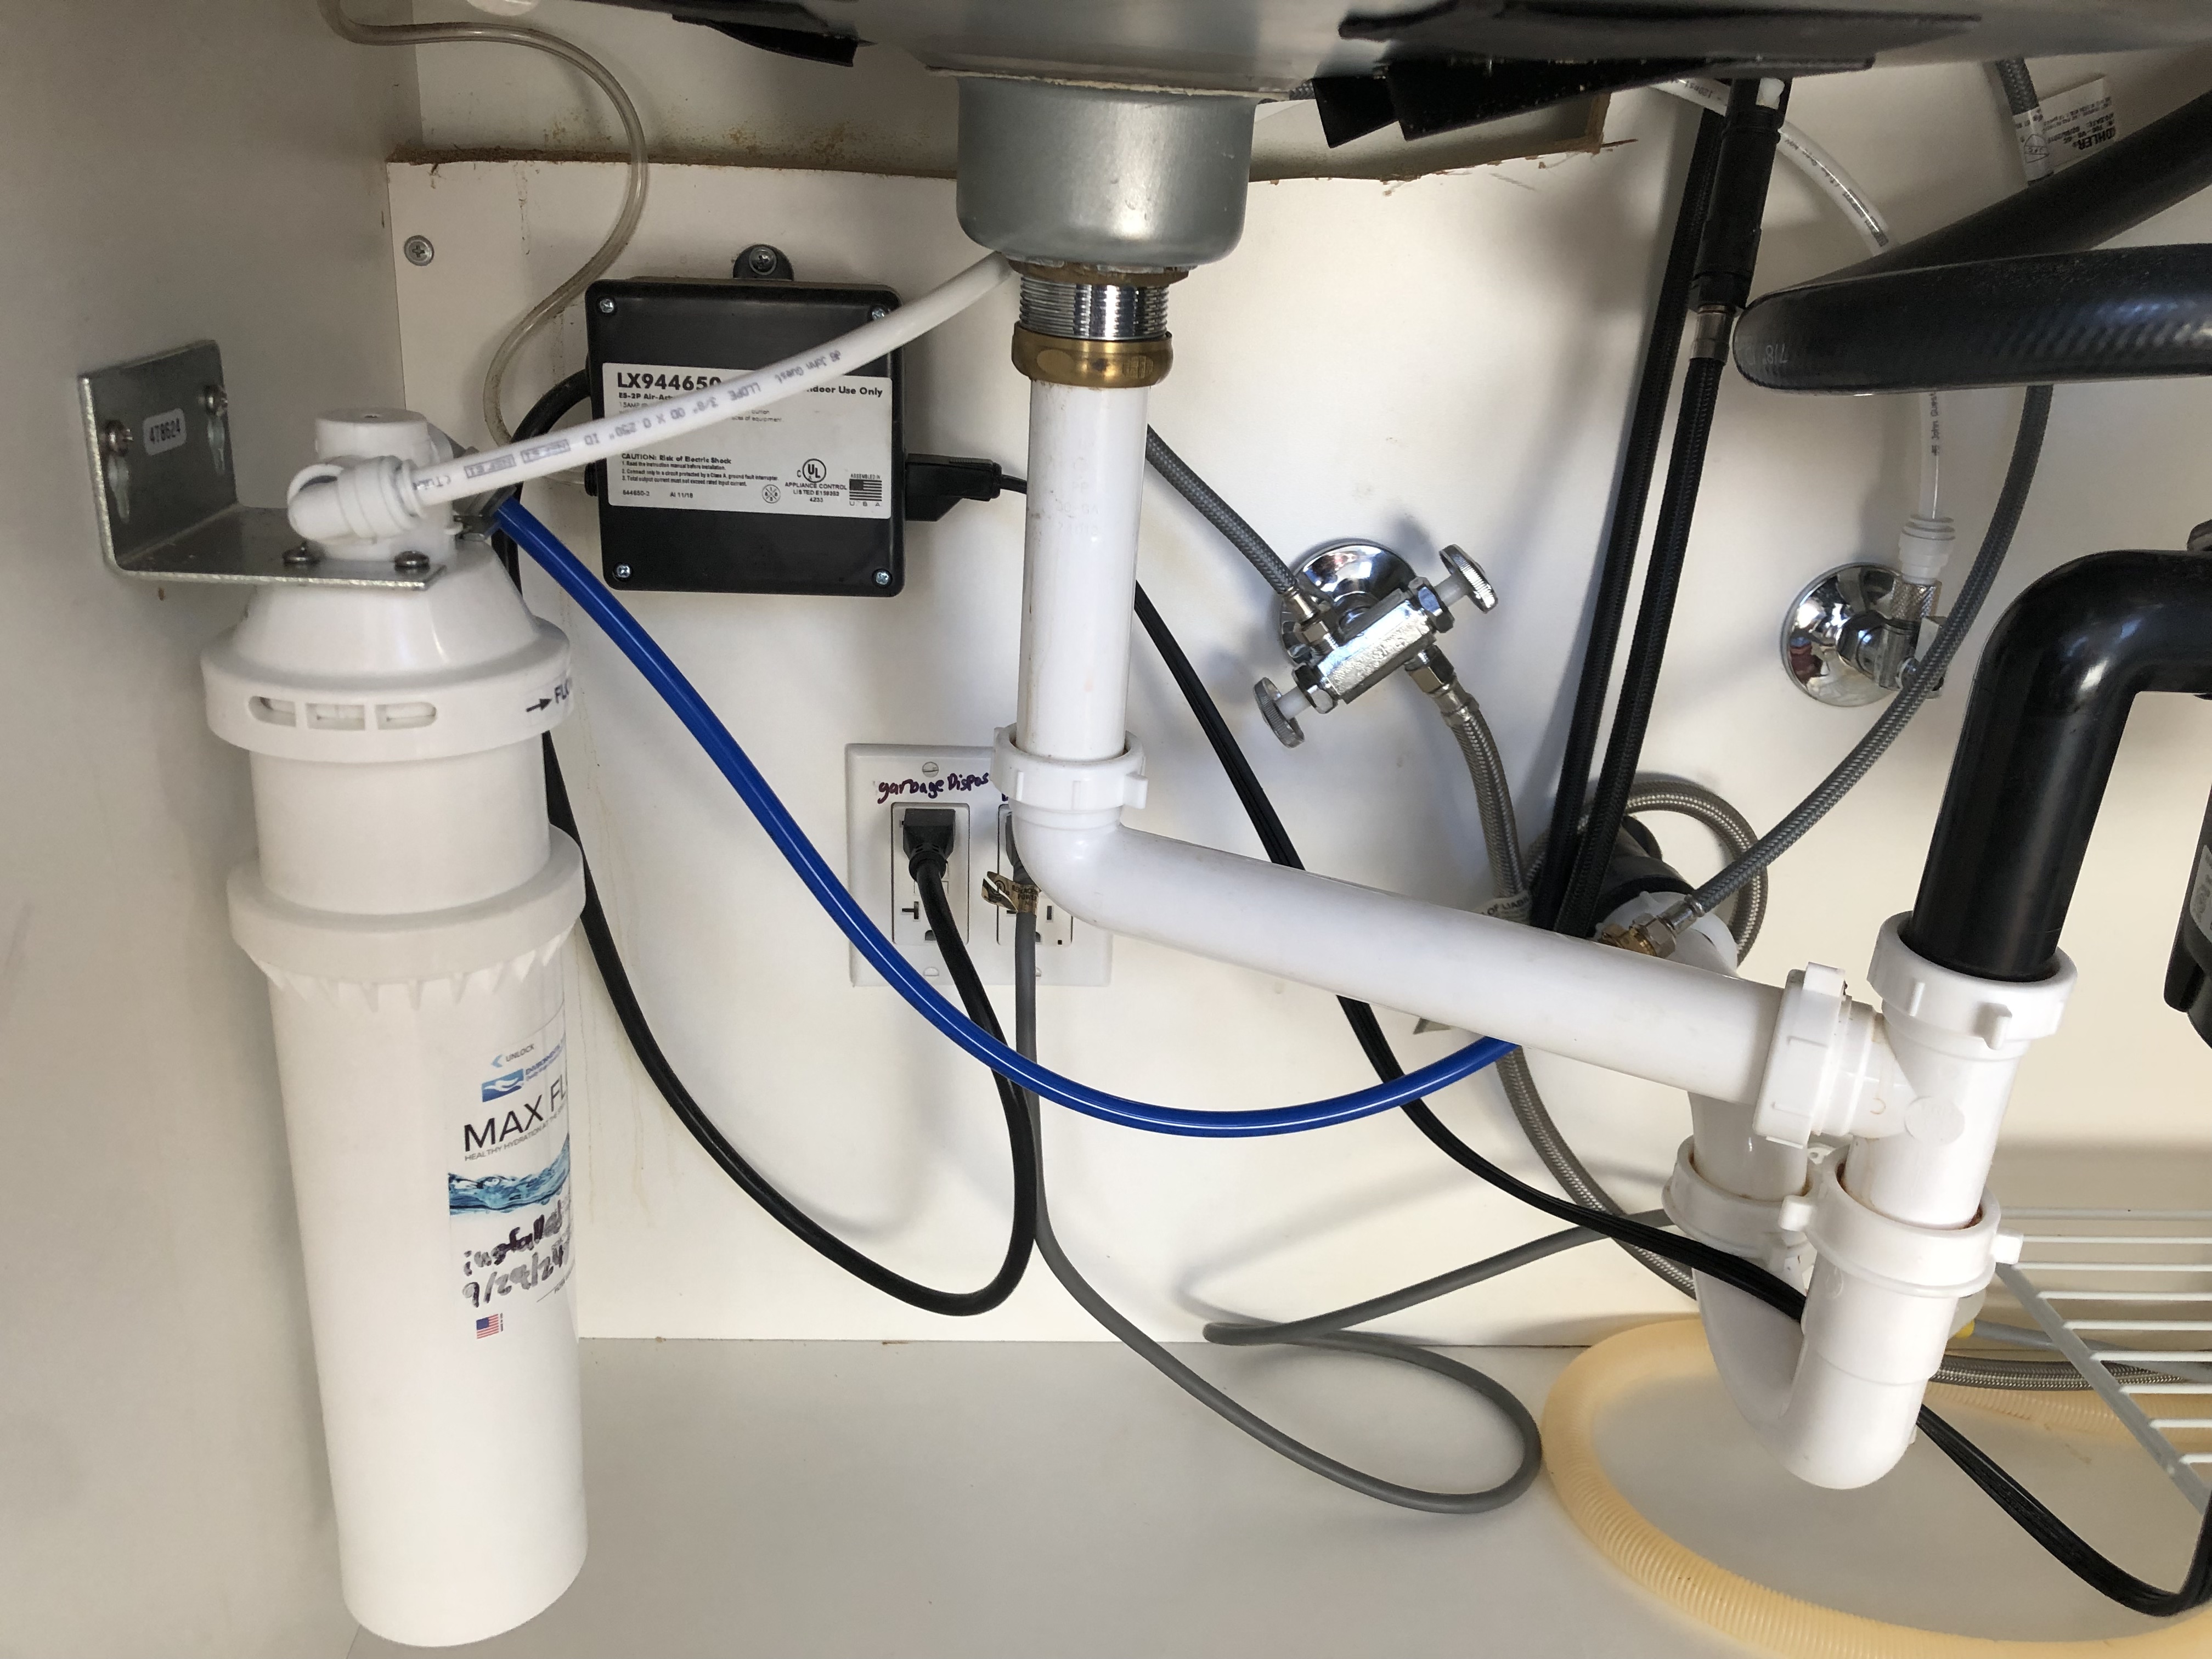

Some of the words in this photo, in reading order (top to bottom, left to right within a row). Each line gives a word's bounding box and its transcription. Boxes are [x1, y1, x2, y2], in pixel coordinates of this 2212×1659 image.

[806, 357, 827, 370] John
[774, 366, 804, 383] Guest
[839, 386, 856, 394] Use
[859, 387, 883, 397] Only
[877, 778, 945, 804] garbage
[947, 772, 989, 791] Dispos
[505, 1043, 534, 1062] UNLOCK
[464, 1094, 544, 1152] MAX
[550, 1074, 567, 1111] FL
[464, 1146, 503, 1162] HEALTHY
[503, 1125, 542, 1150] HYDRATION
